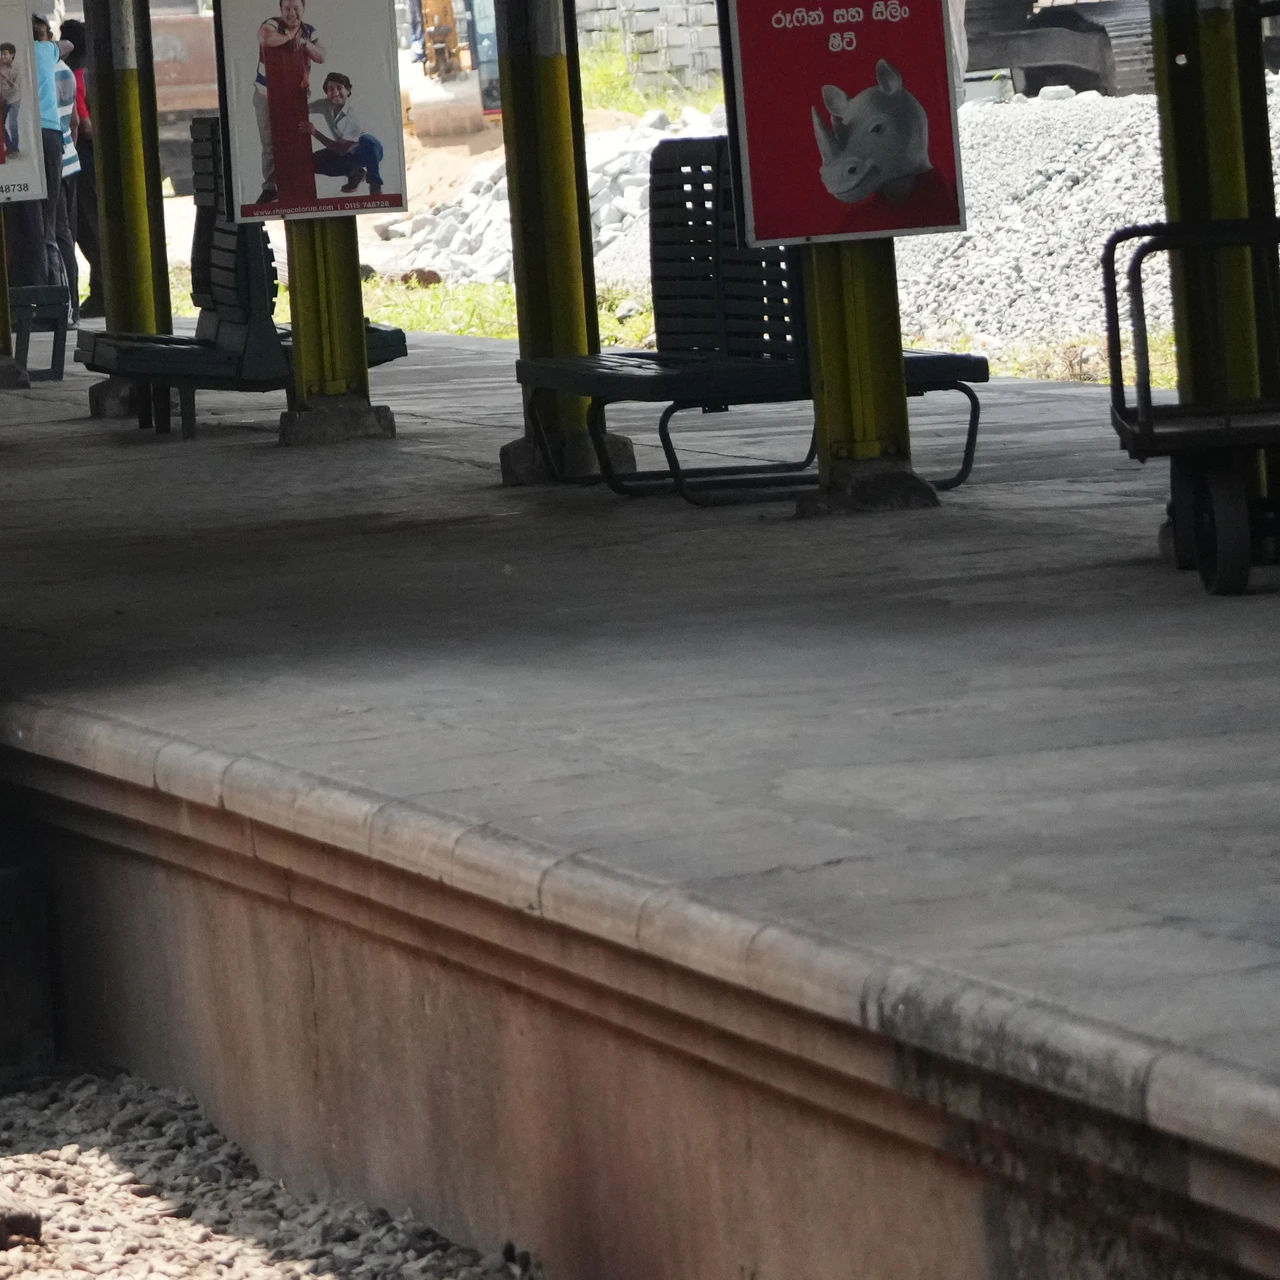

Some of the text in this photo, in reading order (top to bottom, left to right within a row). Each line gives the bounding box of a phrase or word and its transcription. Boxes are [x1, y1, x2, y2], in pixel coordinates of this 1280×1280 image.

[833, 7, 864, 24] සහ
[253, 204, 334, 216] www.rhinocolorup.com
[344, 201, 361, 209] 0115
[363, 200, 390, 208] 748728
